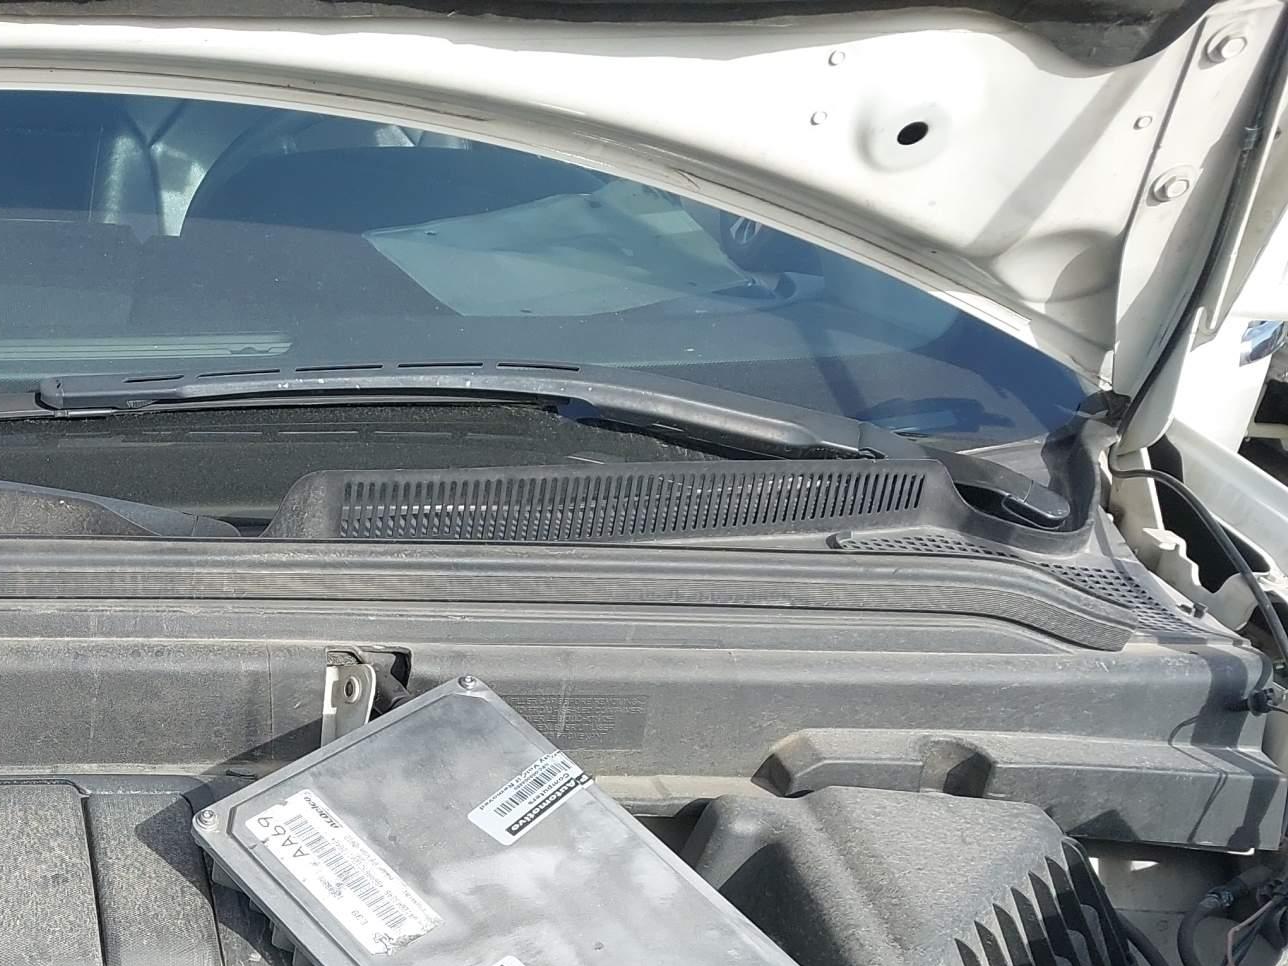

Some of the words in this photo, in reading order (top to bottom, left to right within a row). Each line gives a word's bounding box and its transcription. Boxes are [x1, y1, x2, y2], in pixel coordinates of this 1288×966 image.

[511, 778, 577, 832] Automotive
[527, 773, 570, 805] Computers
[302, 795, 341, 830] ACDelco
[257, 815, 311, 858] AA69
